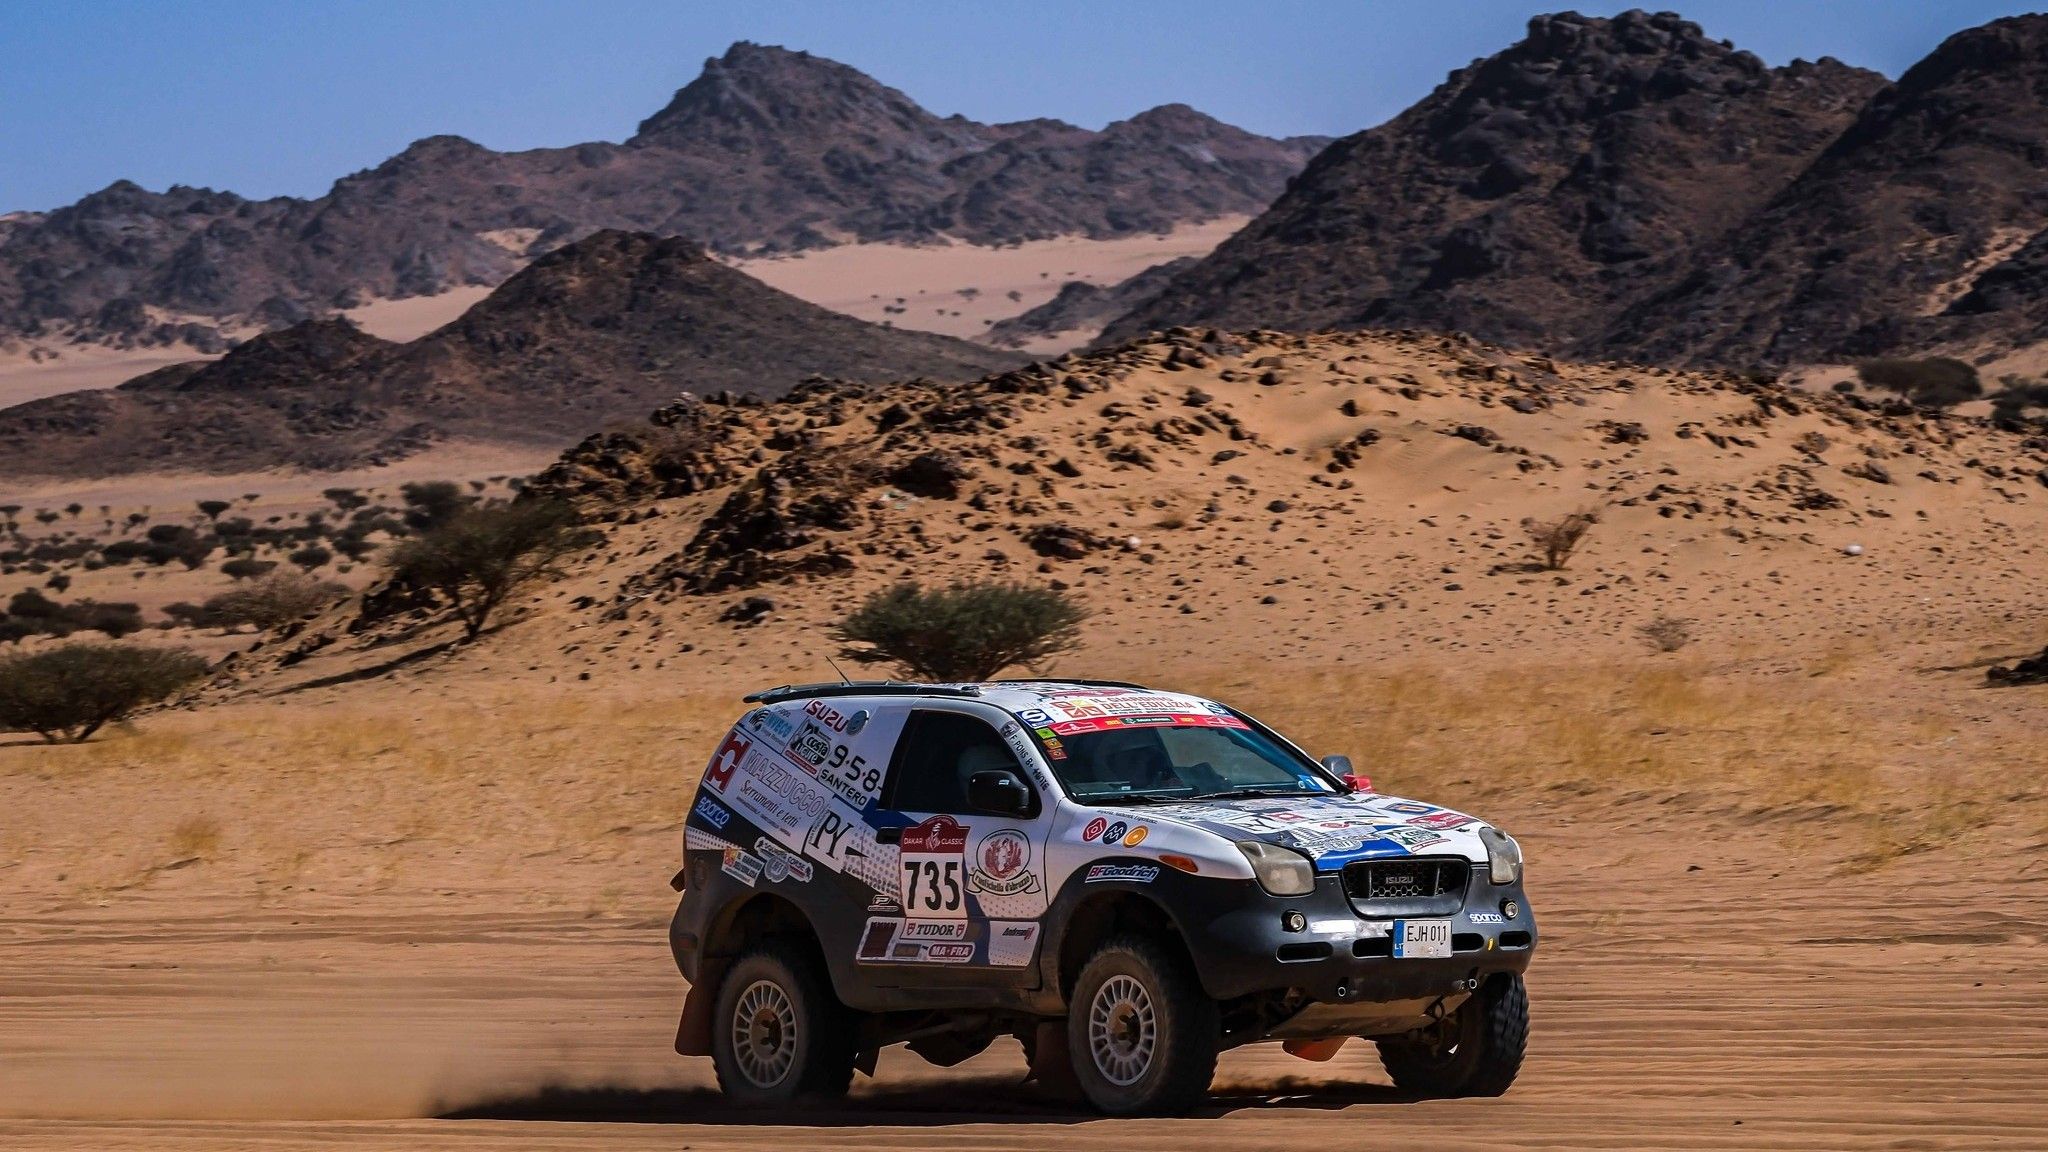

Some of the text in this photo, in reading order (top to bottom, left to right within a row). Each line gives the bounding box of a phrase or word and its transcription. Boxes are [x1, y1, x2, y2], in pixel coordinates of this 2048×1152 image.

[803, 699, 849, 733] ISUZU
[741, 749, 824, 818] MAZZUCCO
[820, 769, 867, 806] SANTERO
[740, 780, 779, 813] Serramenti
[696, 796, 729, 826] sparco
[903, 837, 923, 845] DAKAR
[1089, 865, 1159, 878] BFGoodrich
[1386, 876, 1413, 884] ISUZU
[904, 861, 959, 911] 735
[1469, 913, 1502, 922] sparco
[917, 925, 955, 936] TUDOR
[1407, 926, 1446, 941] EJH 011
